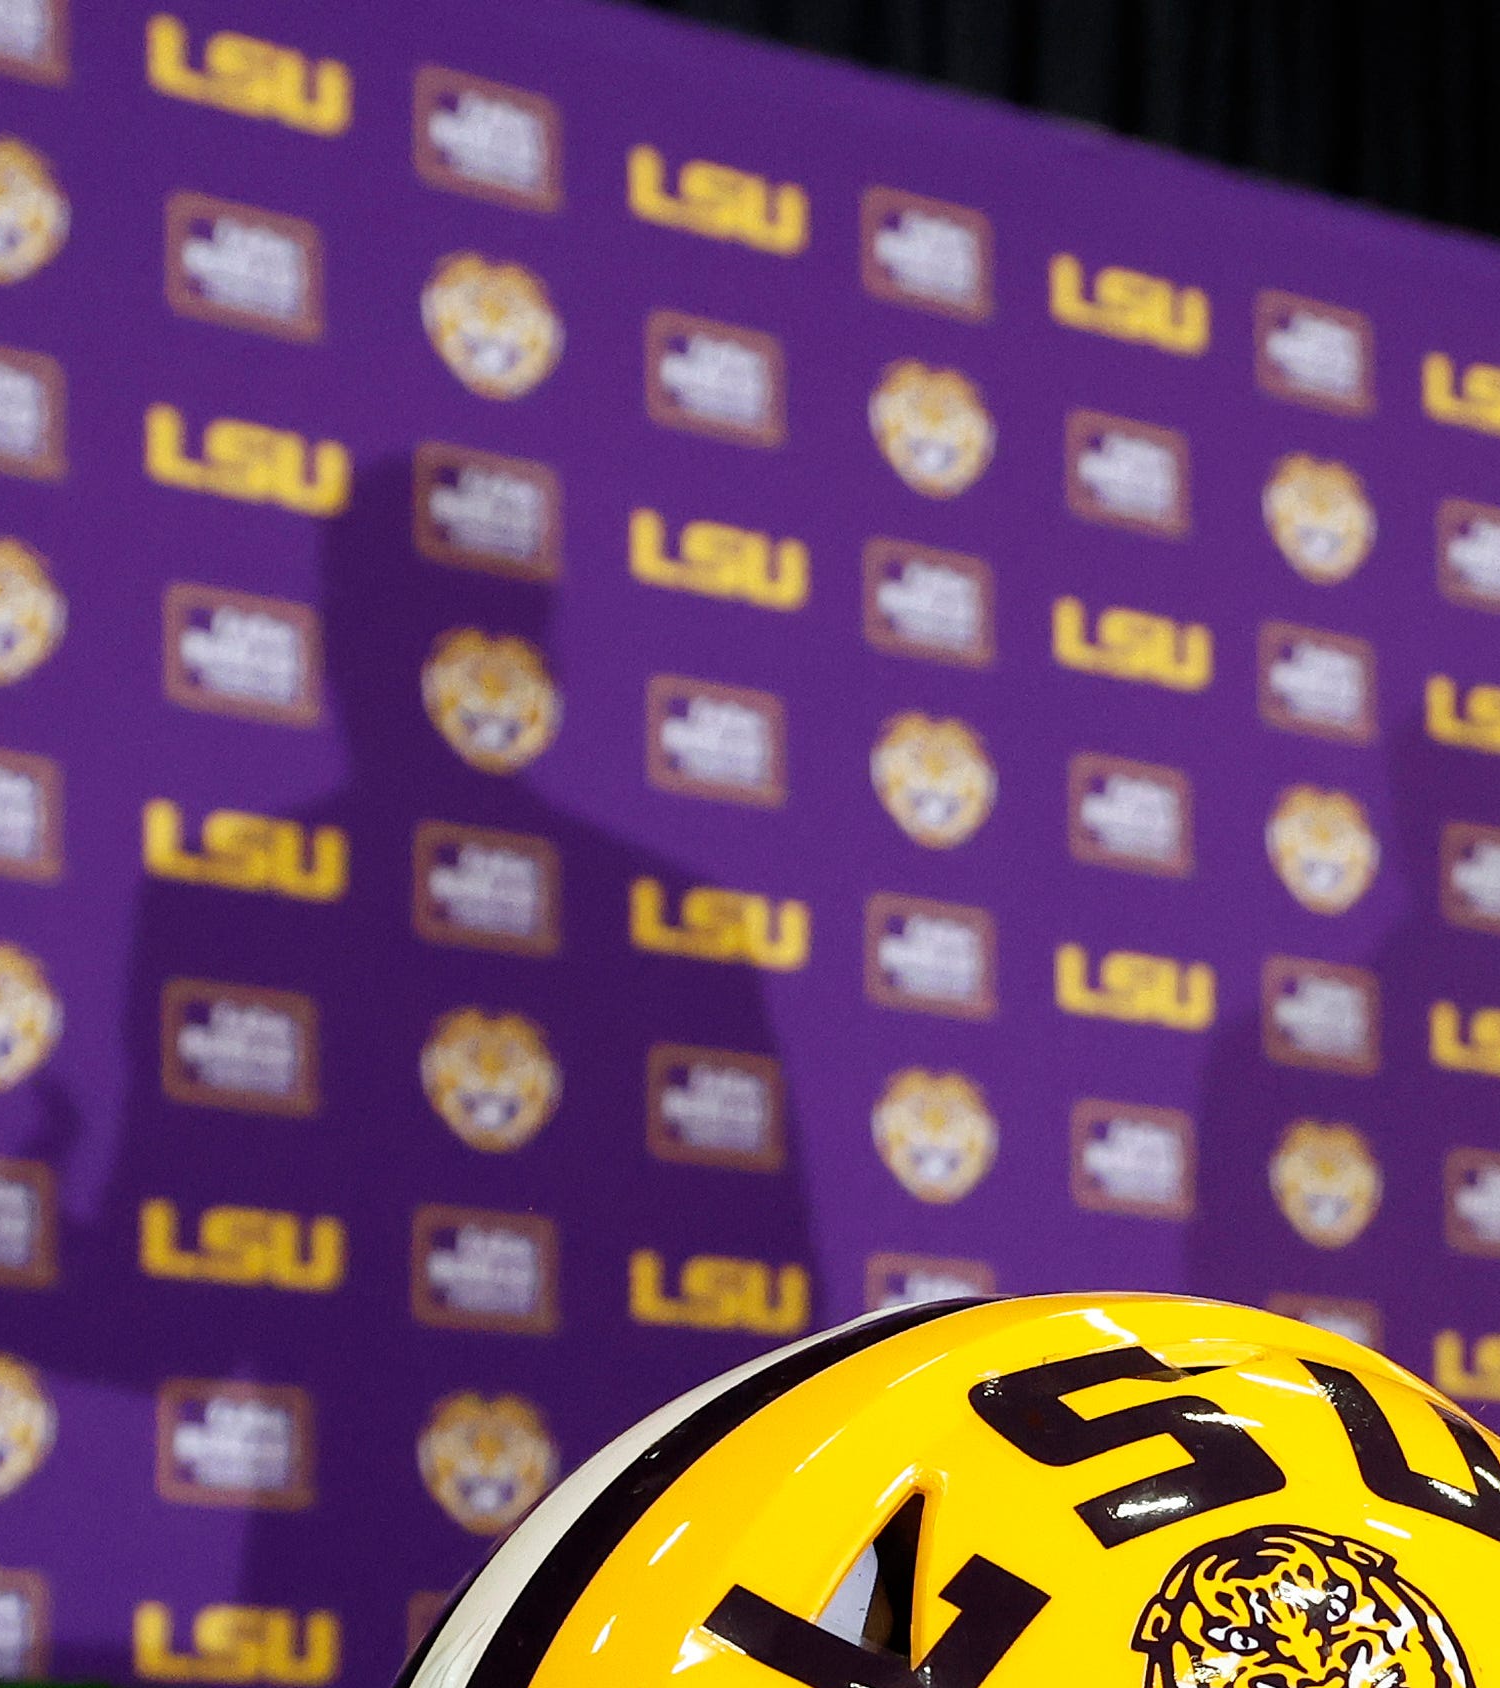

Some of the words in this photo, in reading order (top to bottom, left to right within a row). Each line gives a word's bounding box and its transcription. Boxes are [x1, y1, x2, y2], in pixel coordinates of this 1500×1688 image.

[147, 16, 350, 134] LSU
[628, 146, 807, 253] LSU
[1050, 255, 1209, 352] LSU
[145, 406, 349, 515] LSU
[629, 511, 808, 609] LSU
[1052, 599, 1211, 689] LSU
[143, 799, 348, 901] LSU
[629, 878, 809, 969] LSU
[1055, 944, 1214, 1031] LSU
[140, 1199, 344, 1291] LSU
[628, 1250, 809, 1336] LSU
[133, 1603, 339, 1687] LSU
